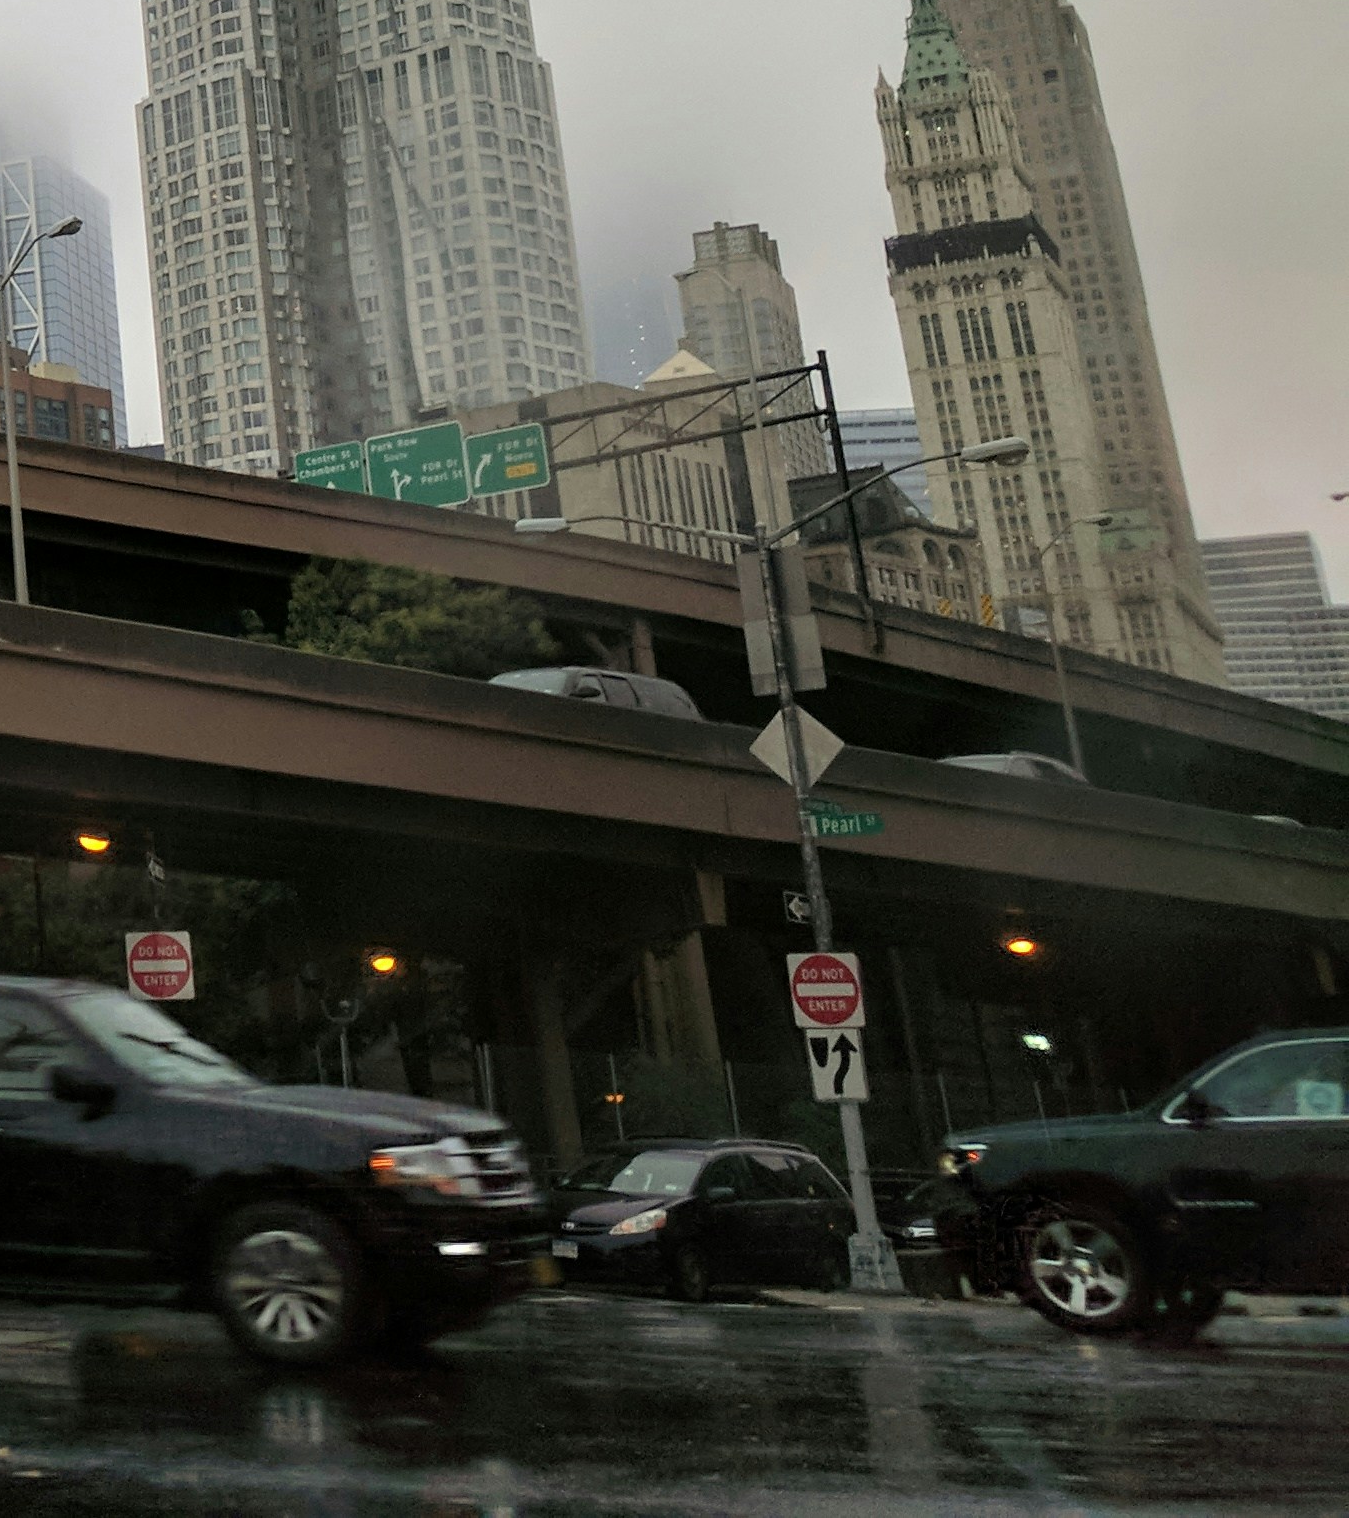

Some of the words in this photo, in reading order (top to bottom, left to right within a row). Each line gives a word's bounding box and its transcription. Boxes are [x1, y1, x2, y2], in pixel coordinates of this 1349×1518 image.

[370, 441, 394, 453] Park
[305, 452, 337, 467] Centre
[299, 462, 347, 479] Chambers
[420, 471, 448, 485] Pearl
[822, 815, 862, 834] Pearl
[138, 946, 154, 957] DO
[157, 945, 179, 957] NOT
[143, 973, 179, 986] ENTER
[801, 969, 818, 980] DO
[821, 968, 844, 980] NOT
[808, 999, 847, 1012] ENTER
